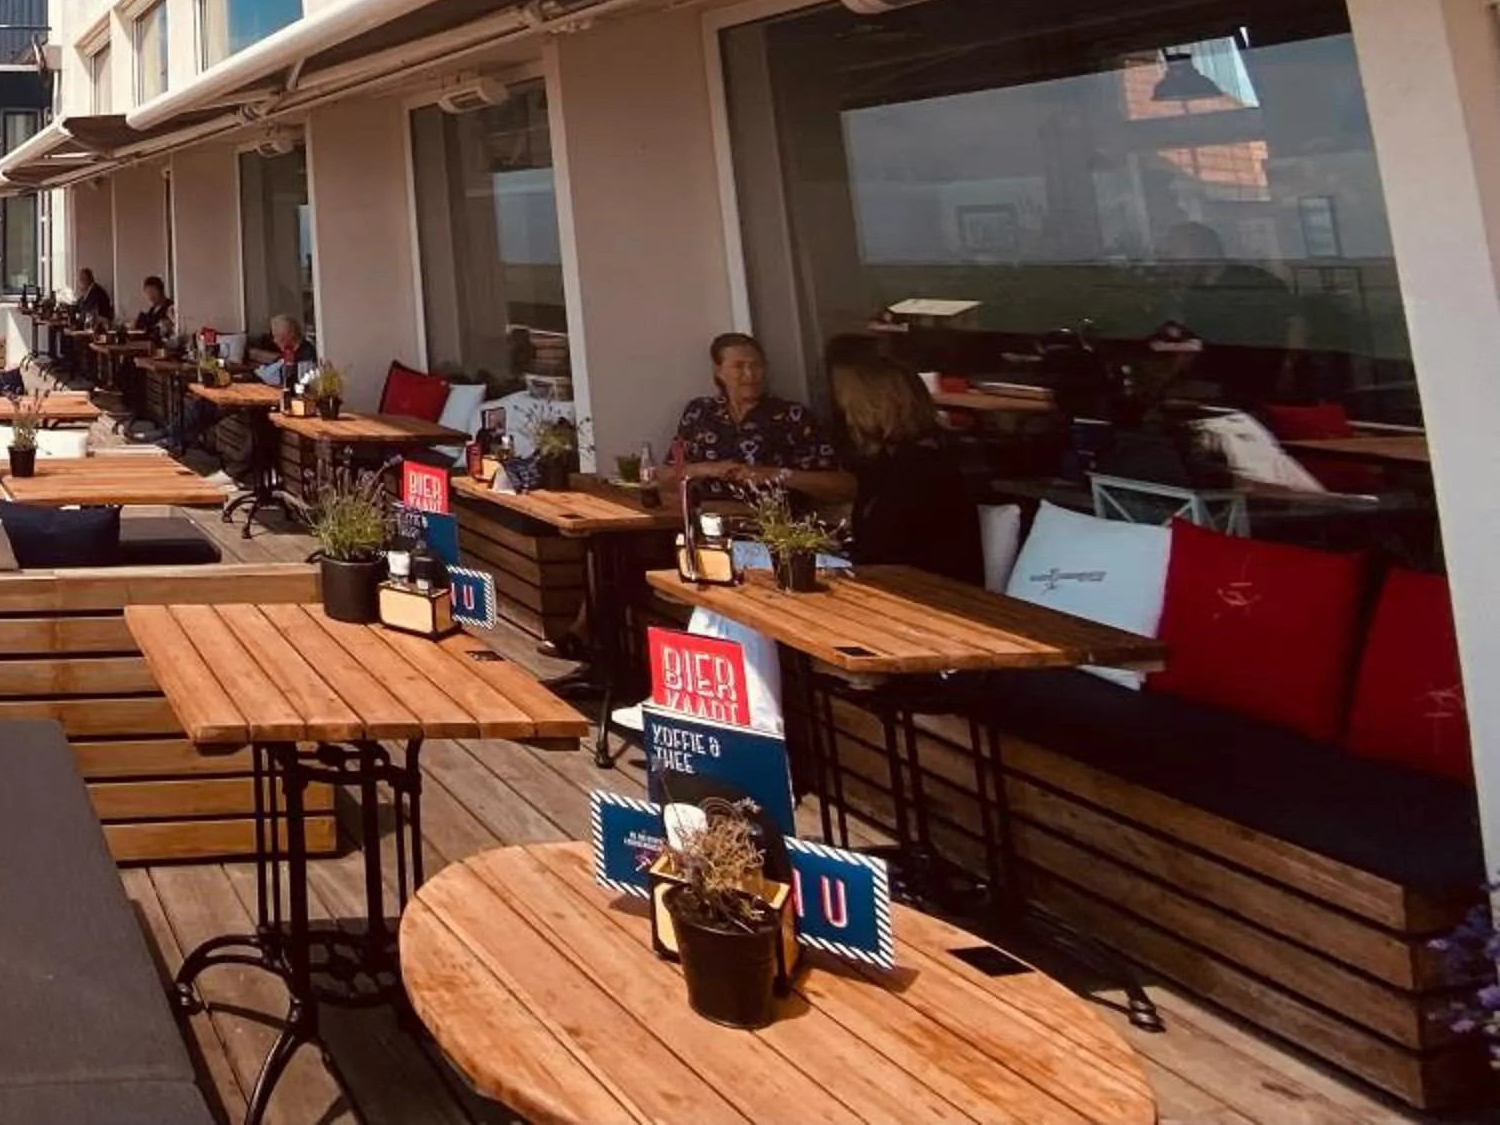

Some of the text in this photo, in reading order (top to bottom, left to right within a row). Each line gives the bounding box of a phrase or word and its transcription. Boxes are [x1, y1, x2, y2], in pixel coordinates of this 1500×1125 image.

[663, 645, 737, 702] BIER
[651, 723, 707, 755] KOFFIE
[653, 745, 695, 774] THEE
